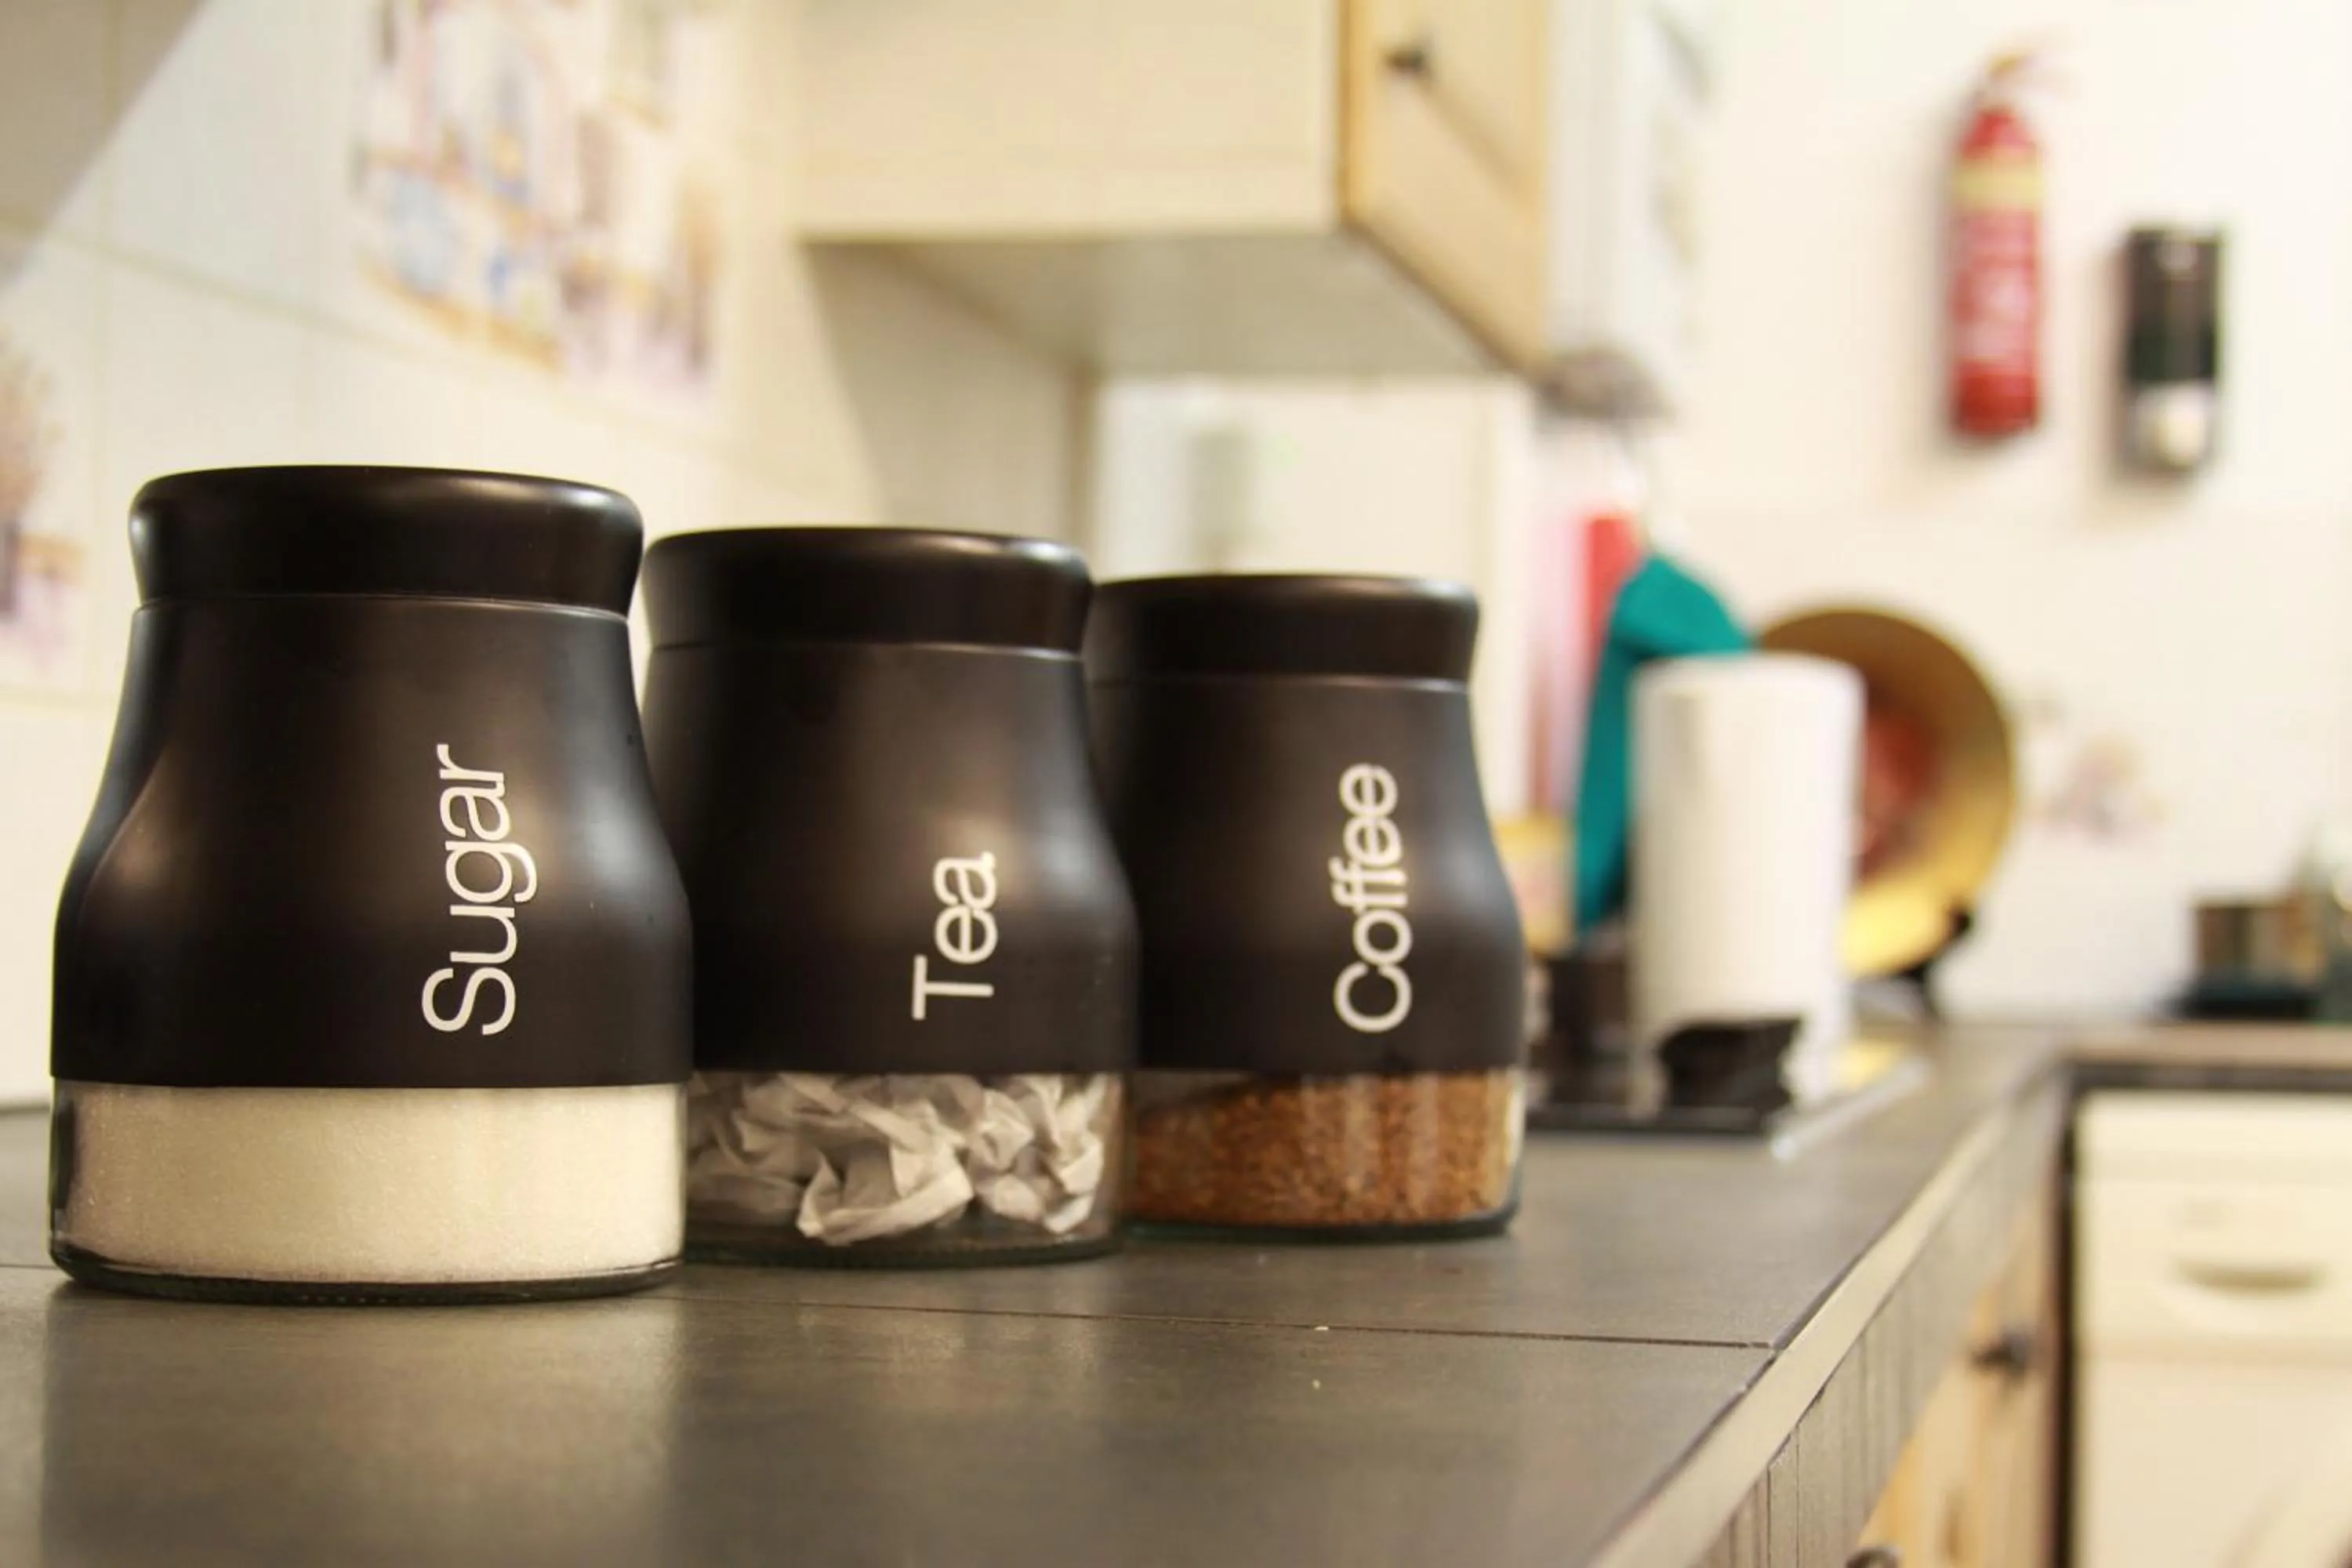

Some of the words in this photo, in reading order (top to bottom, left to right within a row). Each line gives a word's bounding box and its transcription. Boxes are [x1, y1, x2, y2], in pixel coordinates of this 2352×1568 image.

[422, 743, 538, 1035] Sugar
[913, 851, 998, 1020] Tea
[1328, 763, 1413, 1032] Coffee
